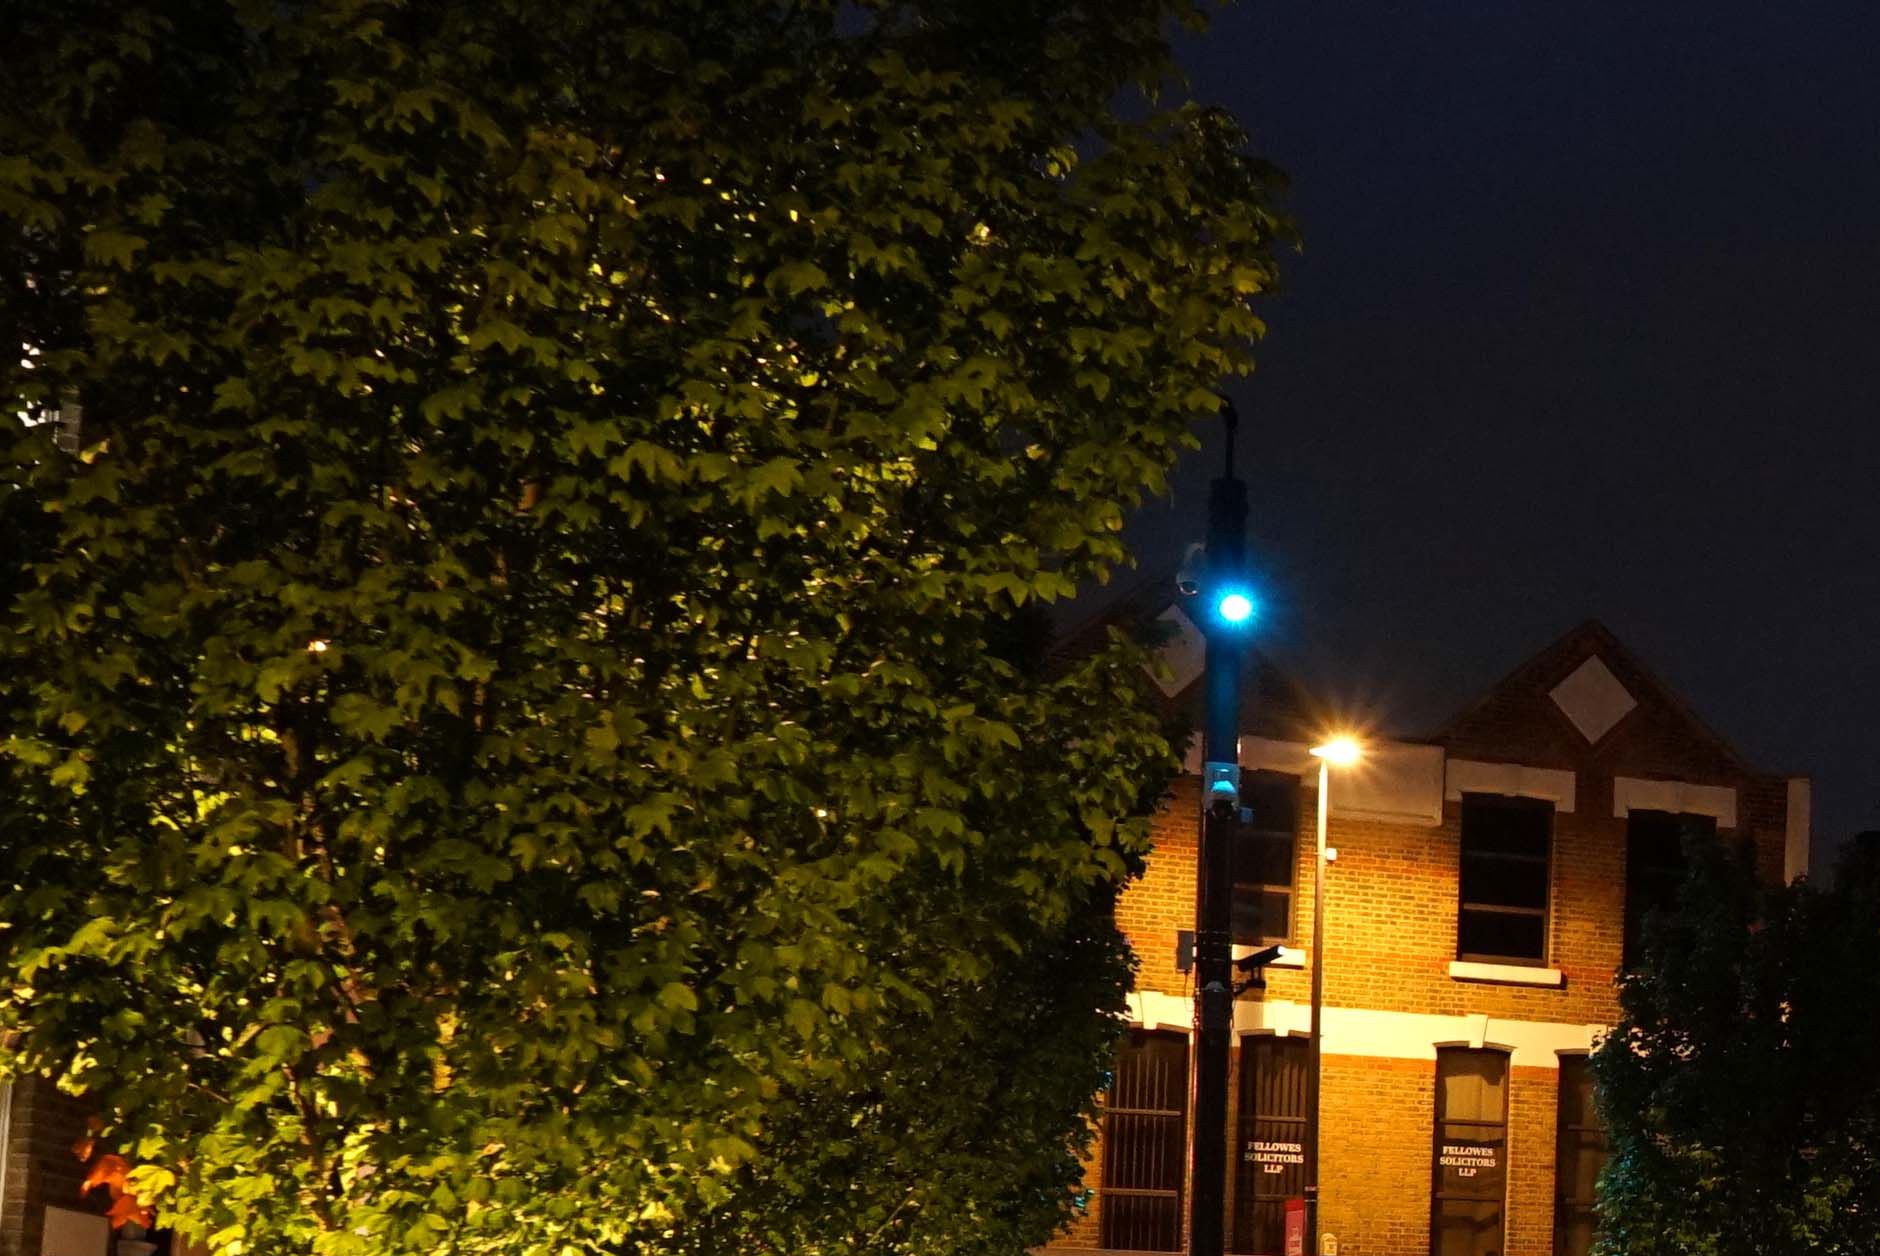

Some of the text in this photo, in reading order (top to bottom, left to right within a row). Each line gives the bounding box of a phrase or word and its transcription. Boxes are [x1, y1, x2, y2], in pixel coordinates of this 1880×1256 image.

[1247, 1141, 1302, 1152] FELLOWES
[1442, 1146, 1494, 1156] FELLOWES
[1244, 1152, 1304, 1163] SOLICITORS
[1439, 1156, 1496, 1167] SOLICITORS
[1263, 1164, 1283, 1173] LLP
[1458, 1168, 1477, 1177] LLP
